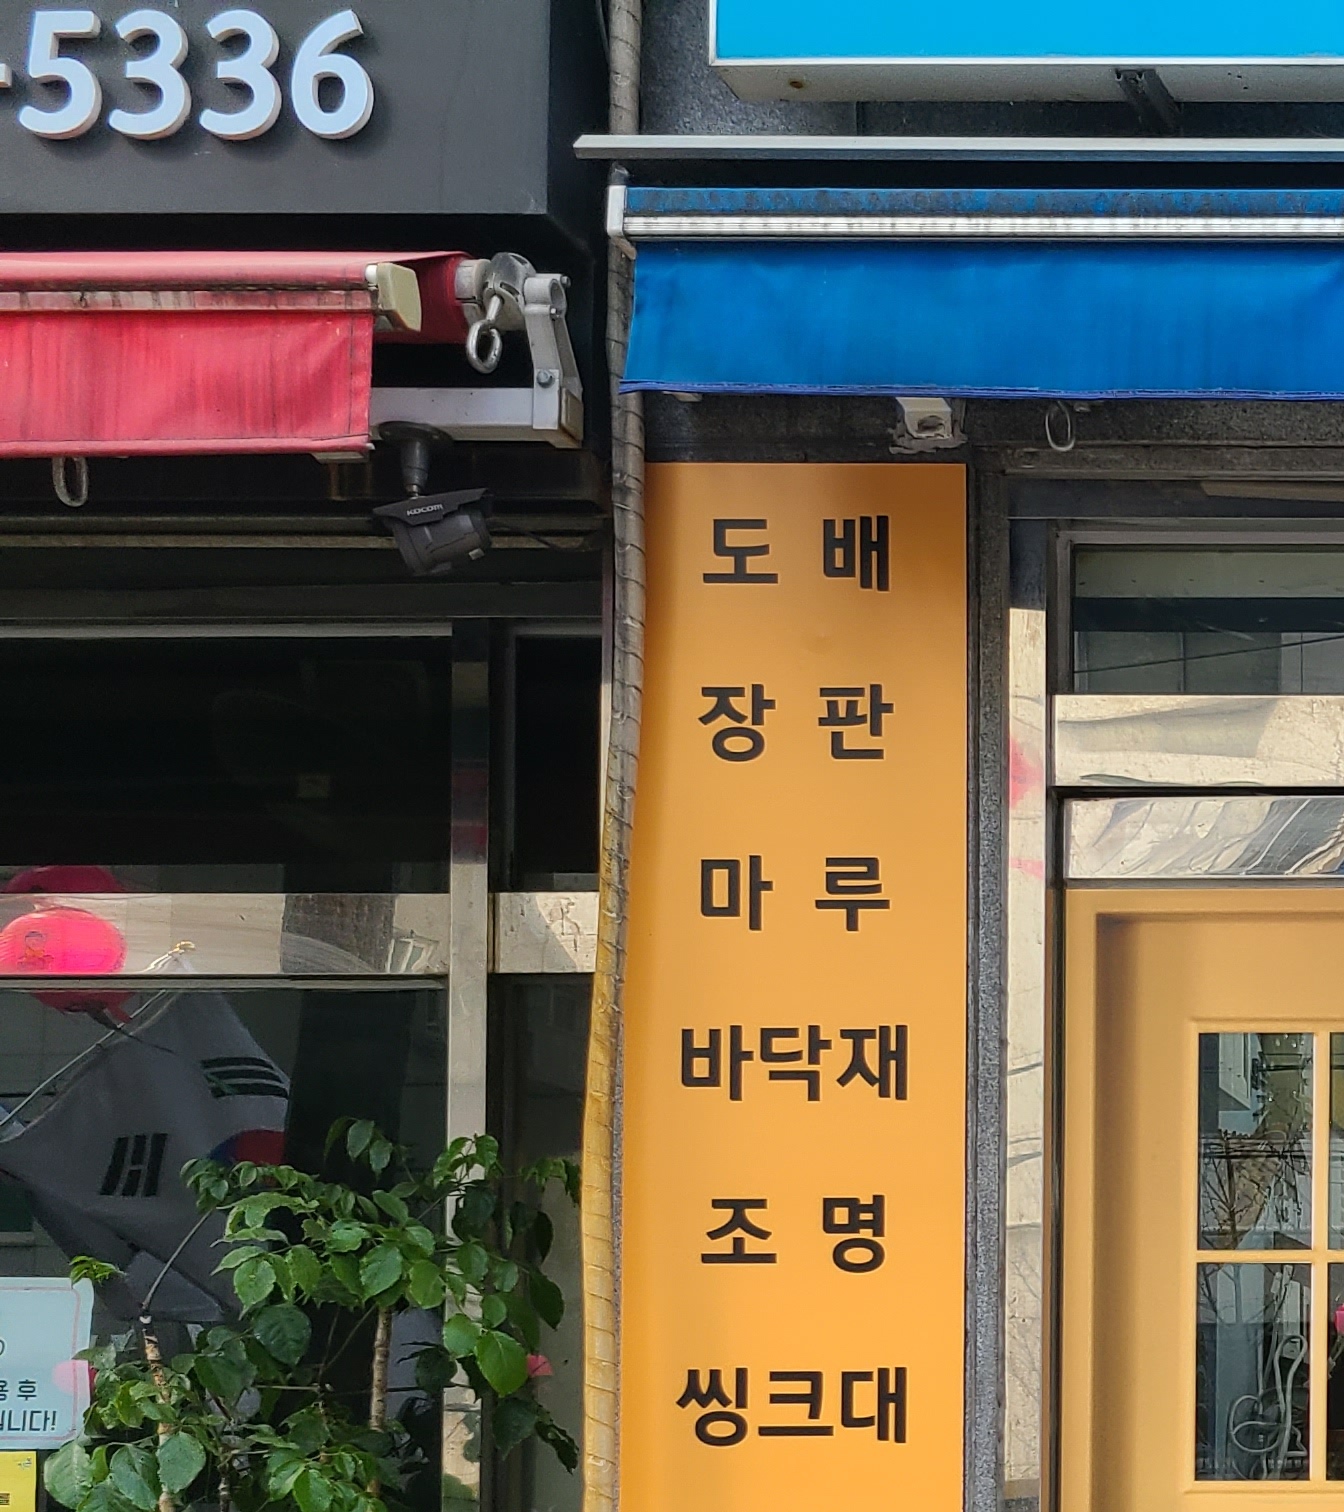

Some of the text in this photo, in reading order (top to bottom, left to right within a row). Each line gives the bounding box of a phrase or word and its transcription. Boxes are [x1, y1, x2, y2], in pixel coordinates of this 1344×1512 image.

[0, 9, 374, 140] 5336
[406, 503, 444, 516] KOCOM
[682, 1025, 907, 1101] 바닥재
[677, 1368, 905, 1446] 씽크대
